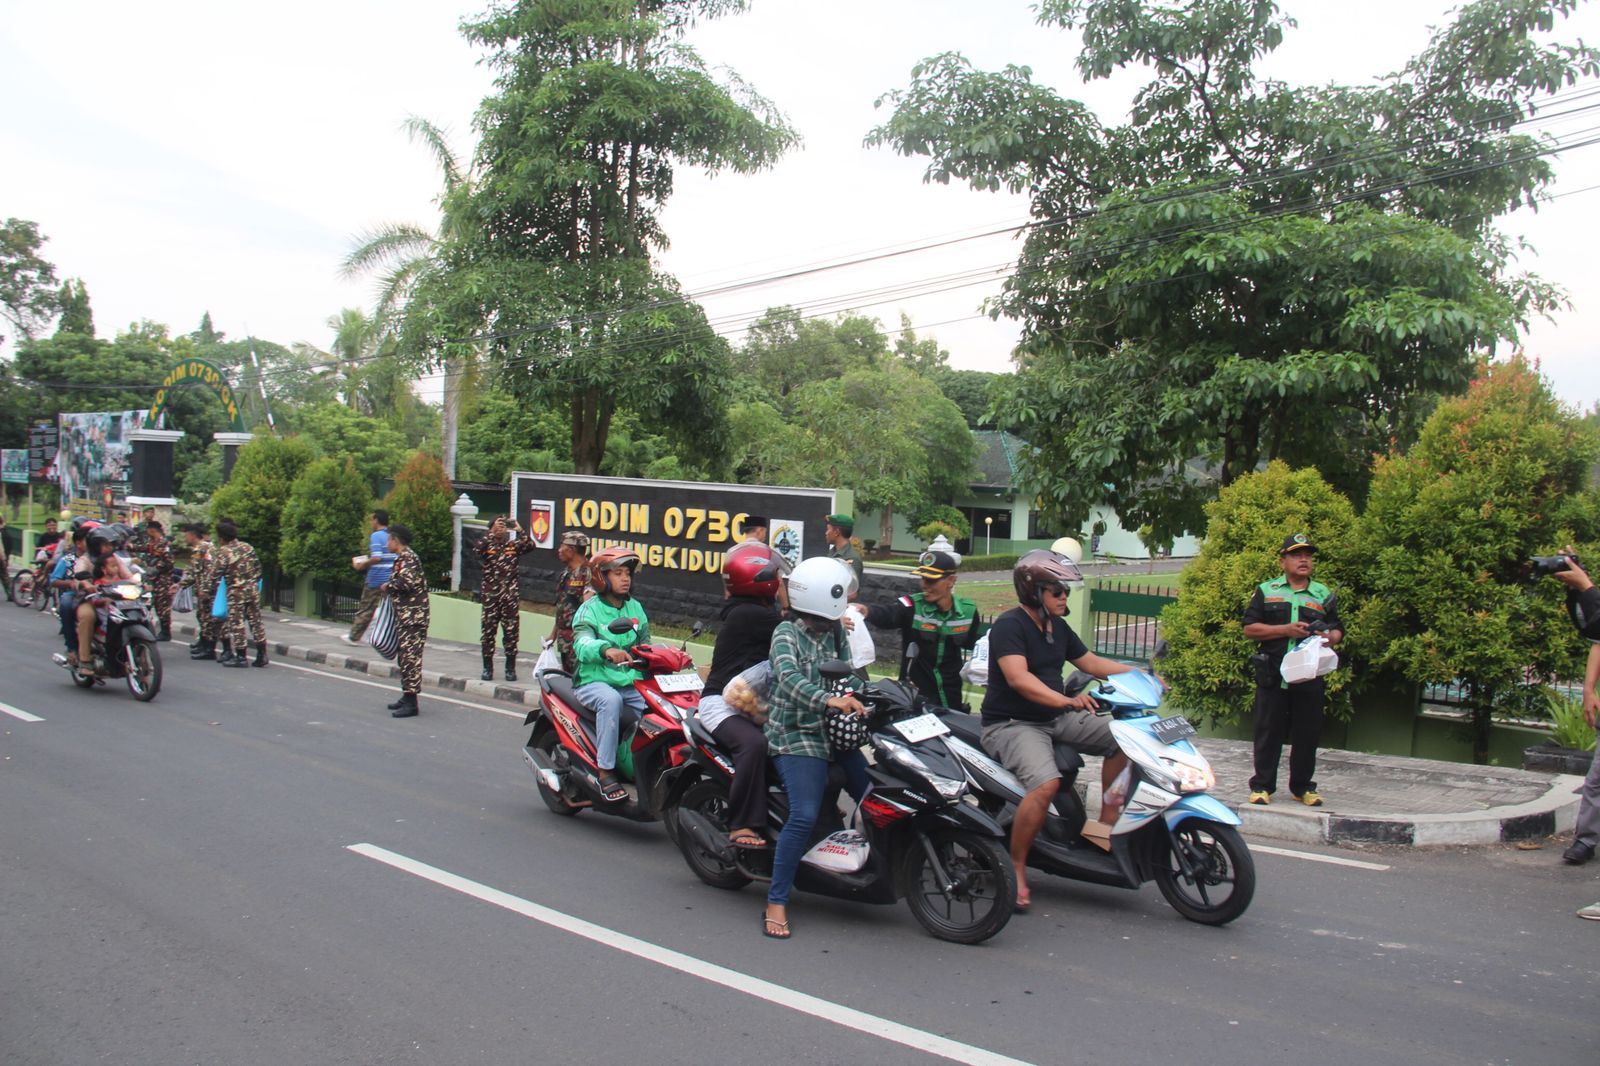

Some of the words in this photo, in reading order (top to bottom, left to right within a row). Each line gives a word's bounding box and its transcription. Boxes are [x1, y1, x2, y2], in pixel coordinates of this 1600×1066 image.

[149, 363, 187, 421] KODIM
[564, 497, 650, 535] KODIM
[585, 537, 728, 575] UNGKIDU
[903, 789, 928, 804] HONDA
[1140, 788, 1167, 801] HONDA
